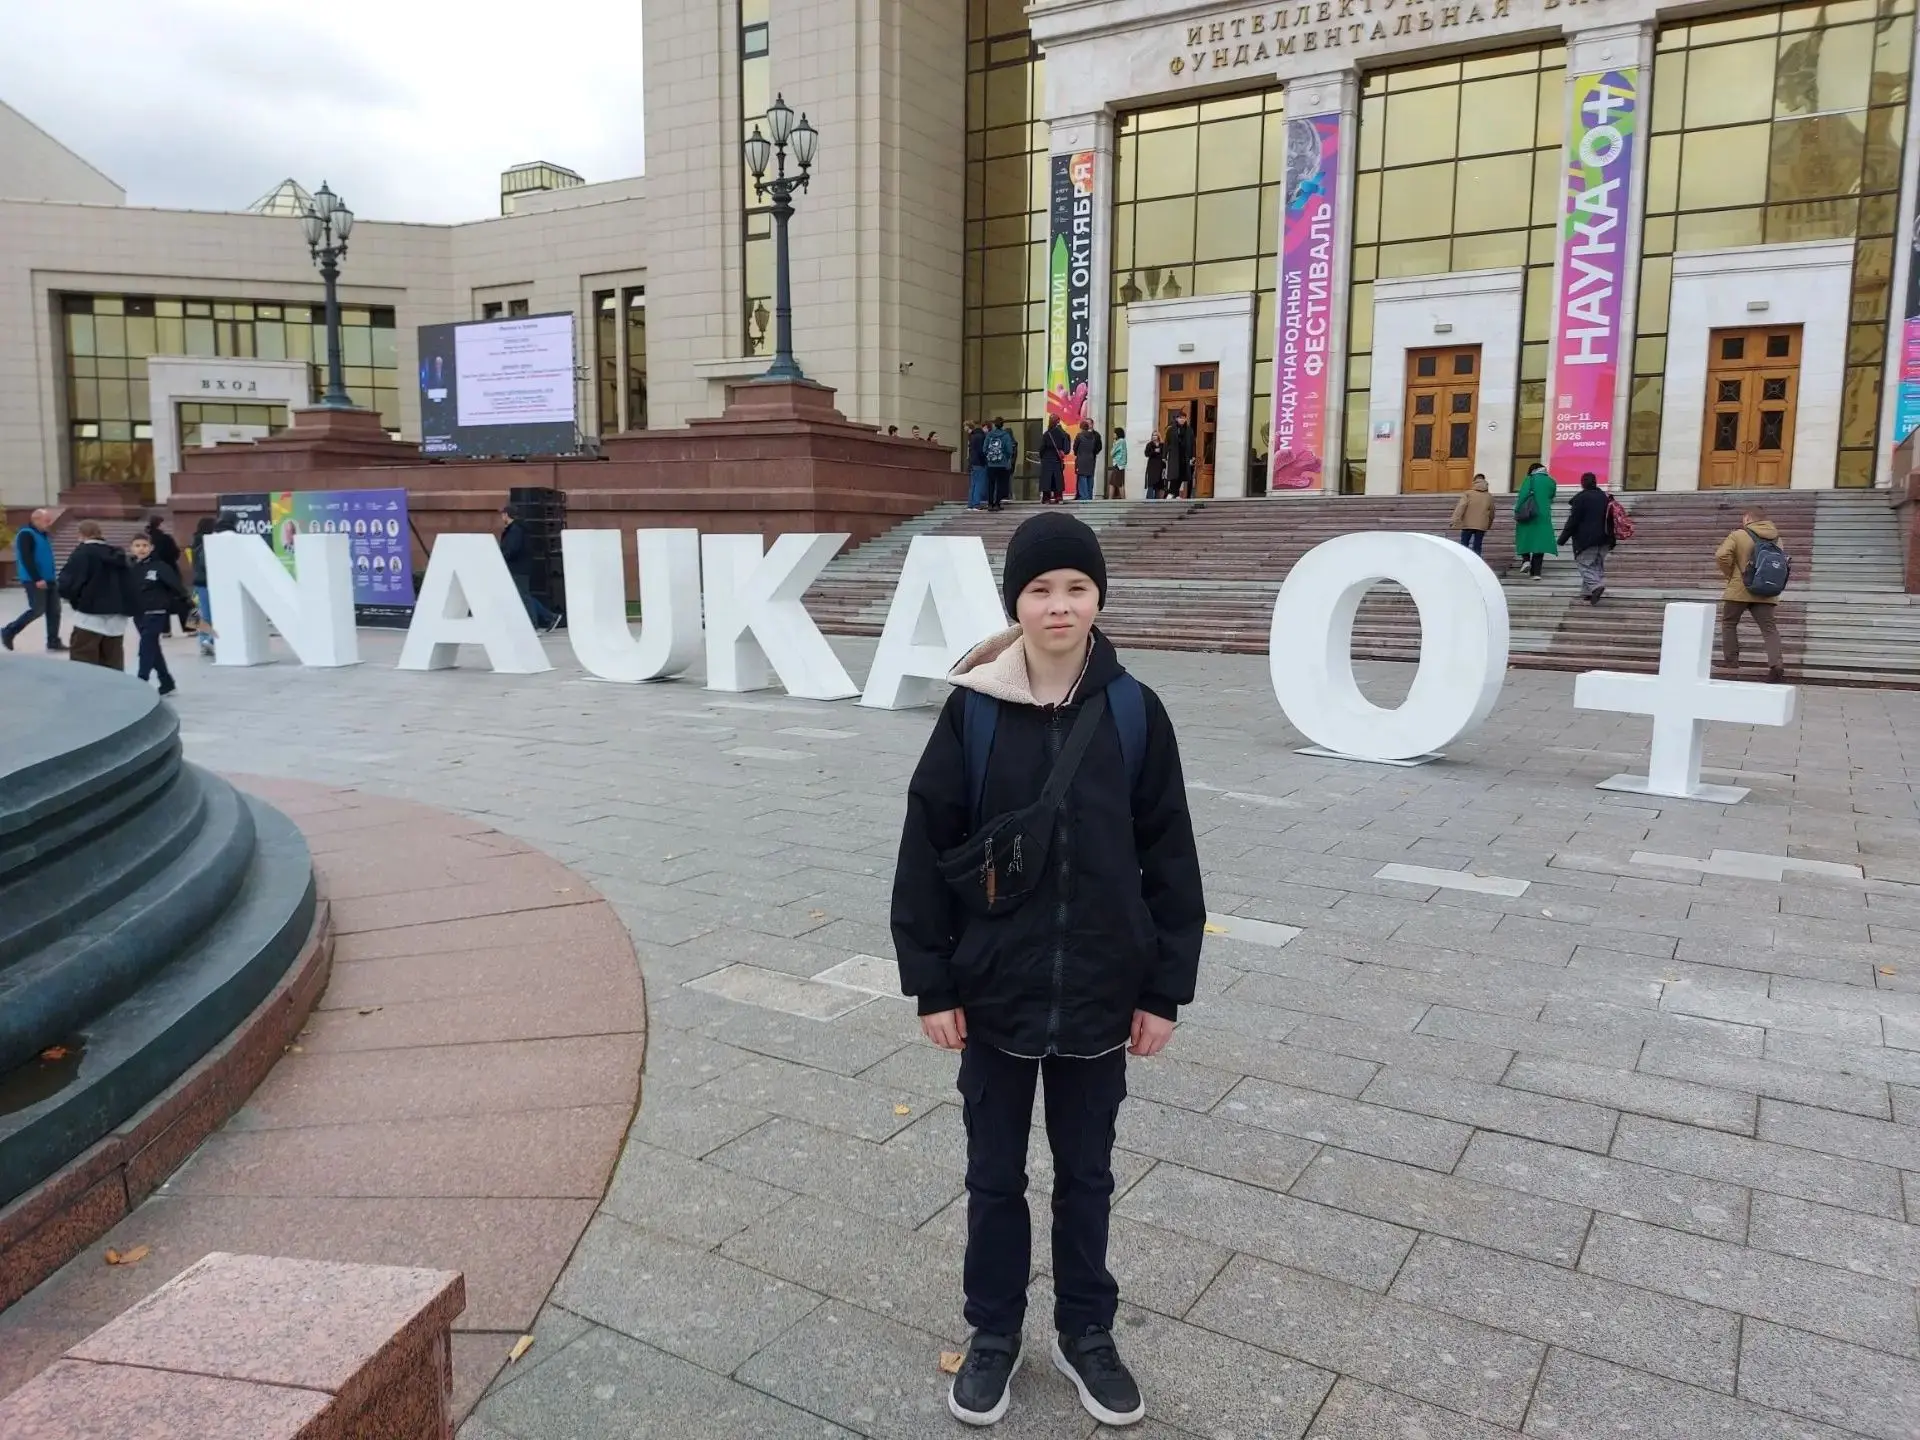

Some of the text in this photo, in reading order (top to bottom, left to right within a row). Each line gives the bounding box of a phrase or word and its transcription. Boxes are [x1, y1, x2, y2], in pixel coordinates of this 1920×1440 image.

[1169, 0, 1510, 75] ФУНДАМЕНТАЛЬНАЯ
[1072, 163, 1091, 287] ОКТЯБРЯ
[1564, 178, 1620, 365] НАУКА
[1052, 272, 1066, 372] ПОЕХАЛИ!
[1304, 203, 1331, 376] ФЕСТИВАЛЬ
[200, 379, 256, 391] ВХОД
[1280, 270, 1302, 451] МЕЖДУНАРОДНЫЙ
[1556, 421, 1609, 431] ОКТЯБРЯ
[1556, 432, 1581, 441] 2026
[204, 528, 1010, 711] NAUKA
